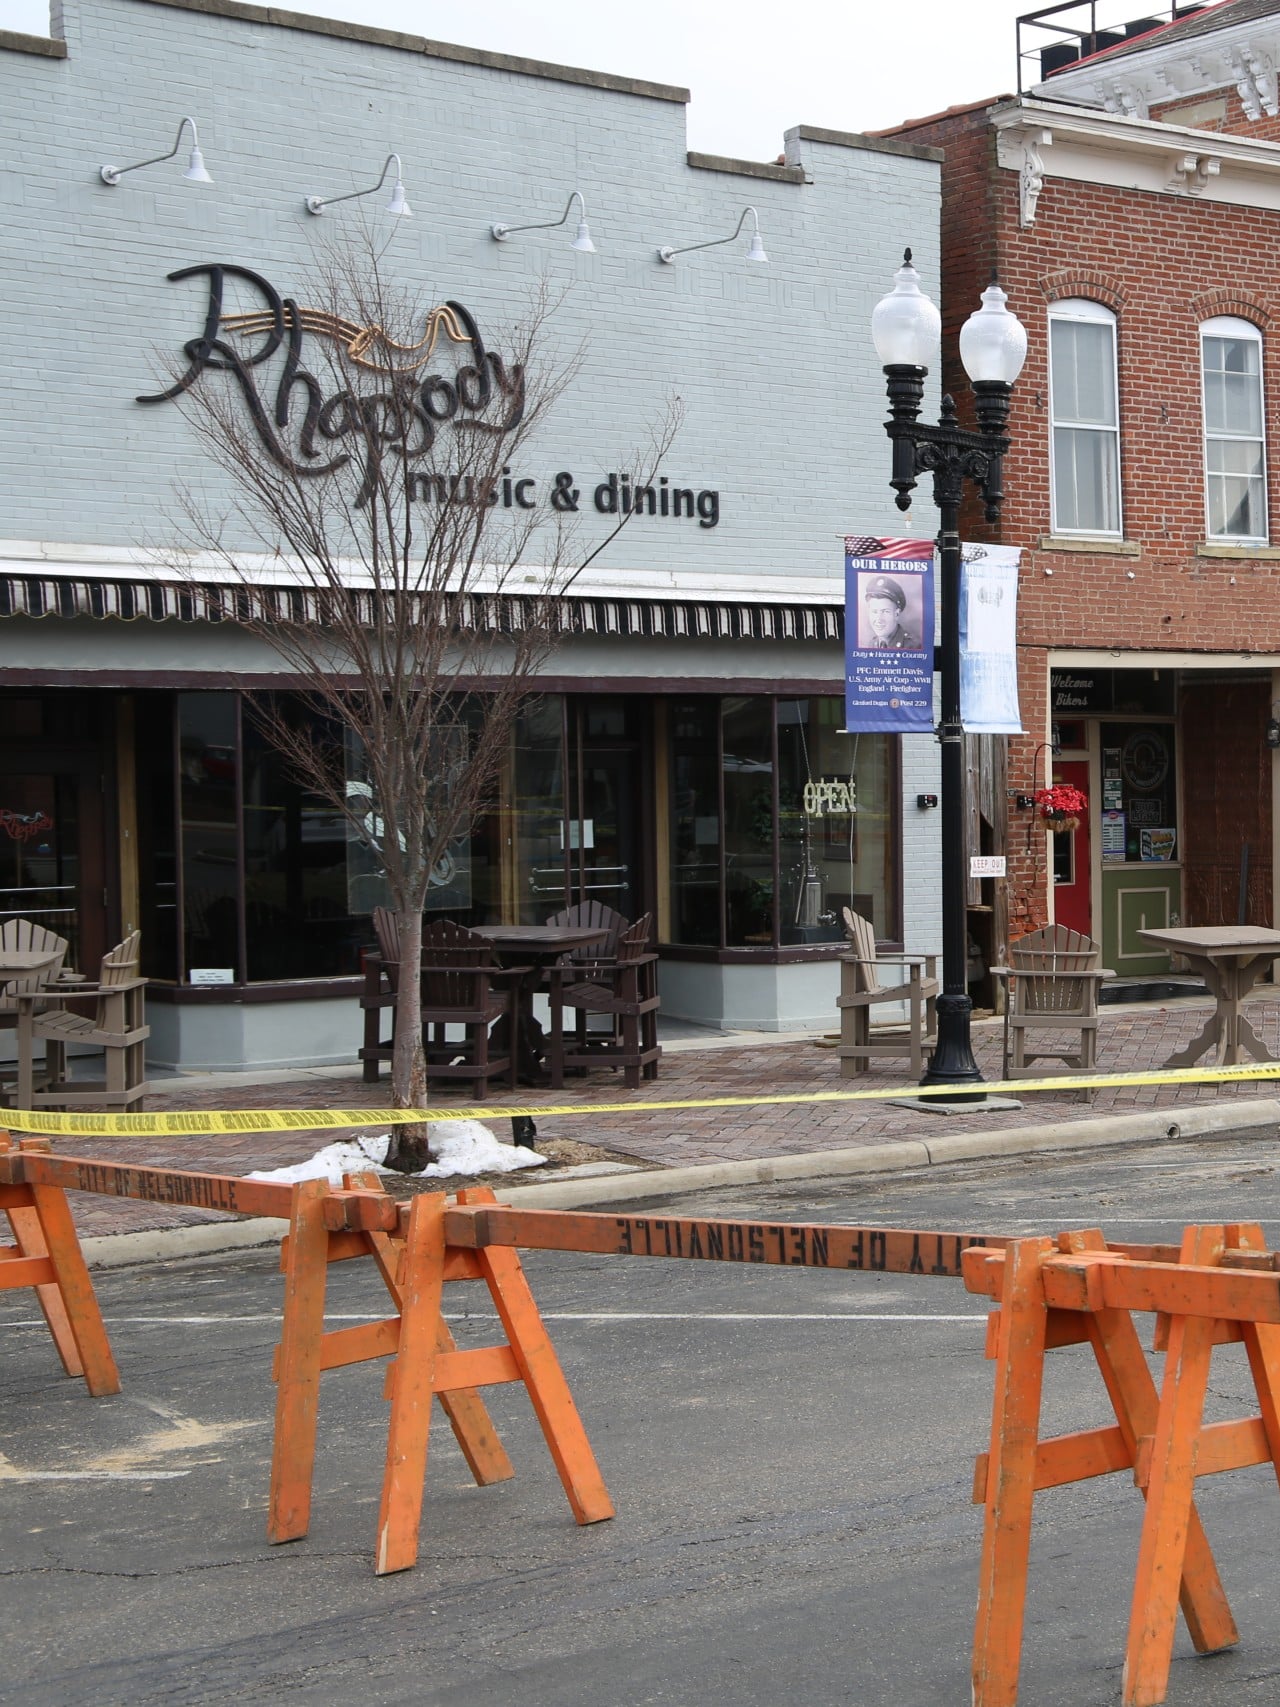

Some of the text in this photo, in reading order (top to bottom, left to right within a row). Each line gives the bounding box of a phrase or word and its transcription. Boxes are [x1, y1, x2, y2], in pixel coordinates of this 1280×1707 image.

[136, 262, 525, 508] Rhapsody
[406, 467, 720, 528] music & dining
[852, 558, 928, 572] OUR HEROES
[852, 650, 868, 659] Duty
[901, 652, 928, 660] Country
[873, 667, 901, 675] Emmett
[903, 667, 924, 675] Davis
[864, 676, 882, 684] Army
[1051, 675, 1094, 688] Welcome
[858, 685, 885, 693] England
[803, 780, 857, 817] OPEN
[138, 1170, 239, 1210] NELSONVILLE
[616, 1219, 987, 1275] ITY OF NELSONVILLE
